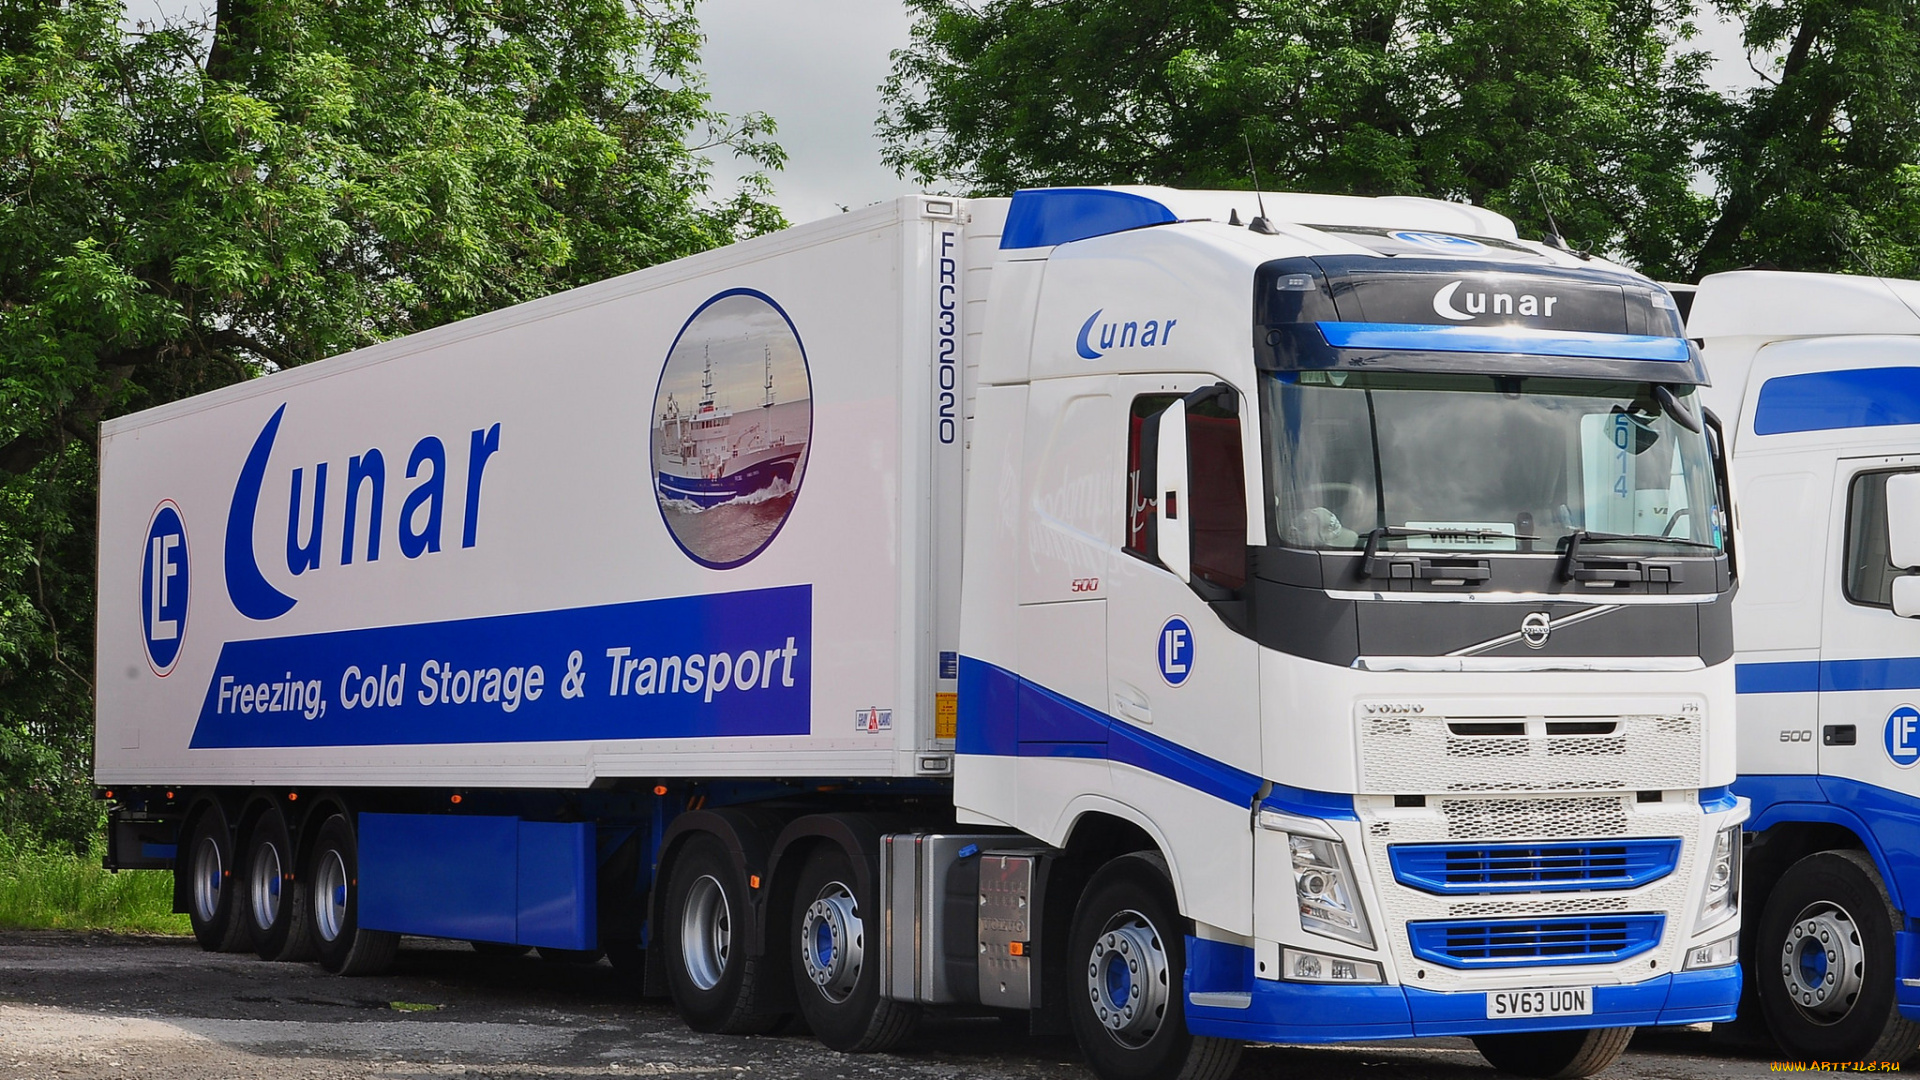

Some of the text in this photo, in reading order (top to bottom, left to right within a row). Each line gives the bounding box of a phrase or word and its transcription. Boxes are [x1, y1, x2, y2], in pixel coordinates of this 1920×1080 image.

[1433, 280, 1557, 320] Lunar
[939, 231, 955, 444] FRC32020
[1076, 309, 1177, 360] Lunar
[224, 403, 501, 620] Lunar
[1071, 578, 1099, 592] 500
[216, 637, 798, 720] Freezing, Cold Storage & Transport
[1363, 704, 1425, 714] VOLVO
[1780, 730, 1812, 742] 500
[1495, 990, 1585, 1014] SV63 UON
